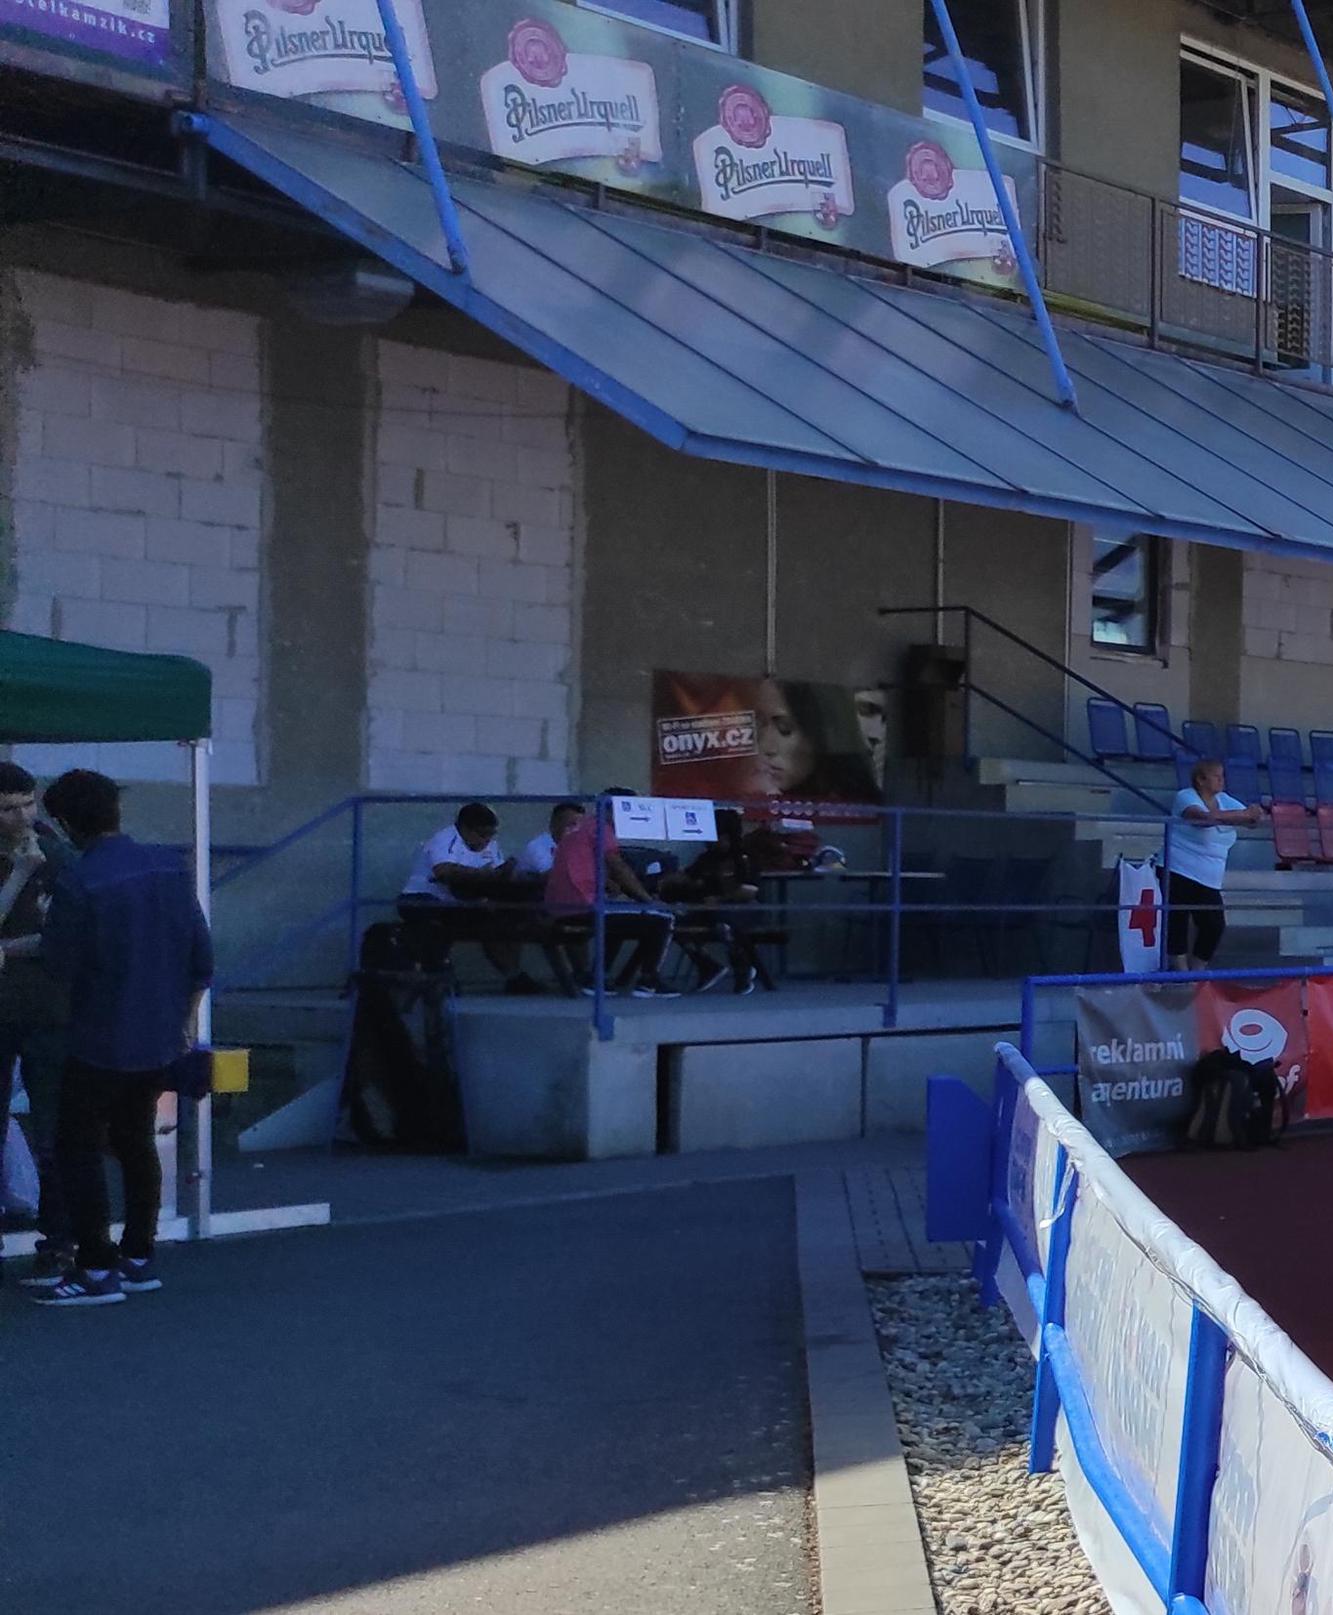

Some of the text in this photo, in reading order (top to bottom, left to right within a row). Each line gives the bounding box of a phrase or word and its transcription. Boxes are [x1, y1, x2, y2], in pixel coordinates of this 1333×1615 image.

[15, 0, 156, 44] telkamzik.cz
[326, 16, 386, 65] Urqu
[956, 199, 1003, 238] Urquel
[663, 728, 754, 754] onyx.cz
[1090, 1034, 1185, 1065] reklamní
